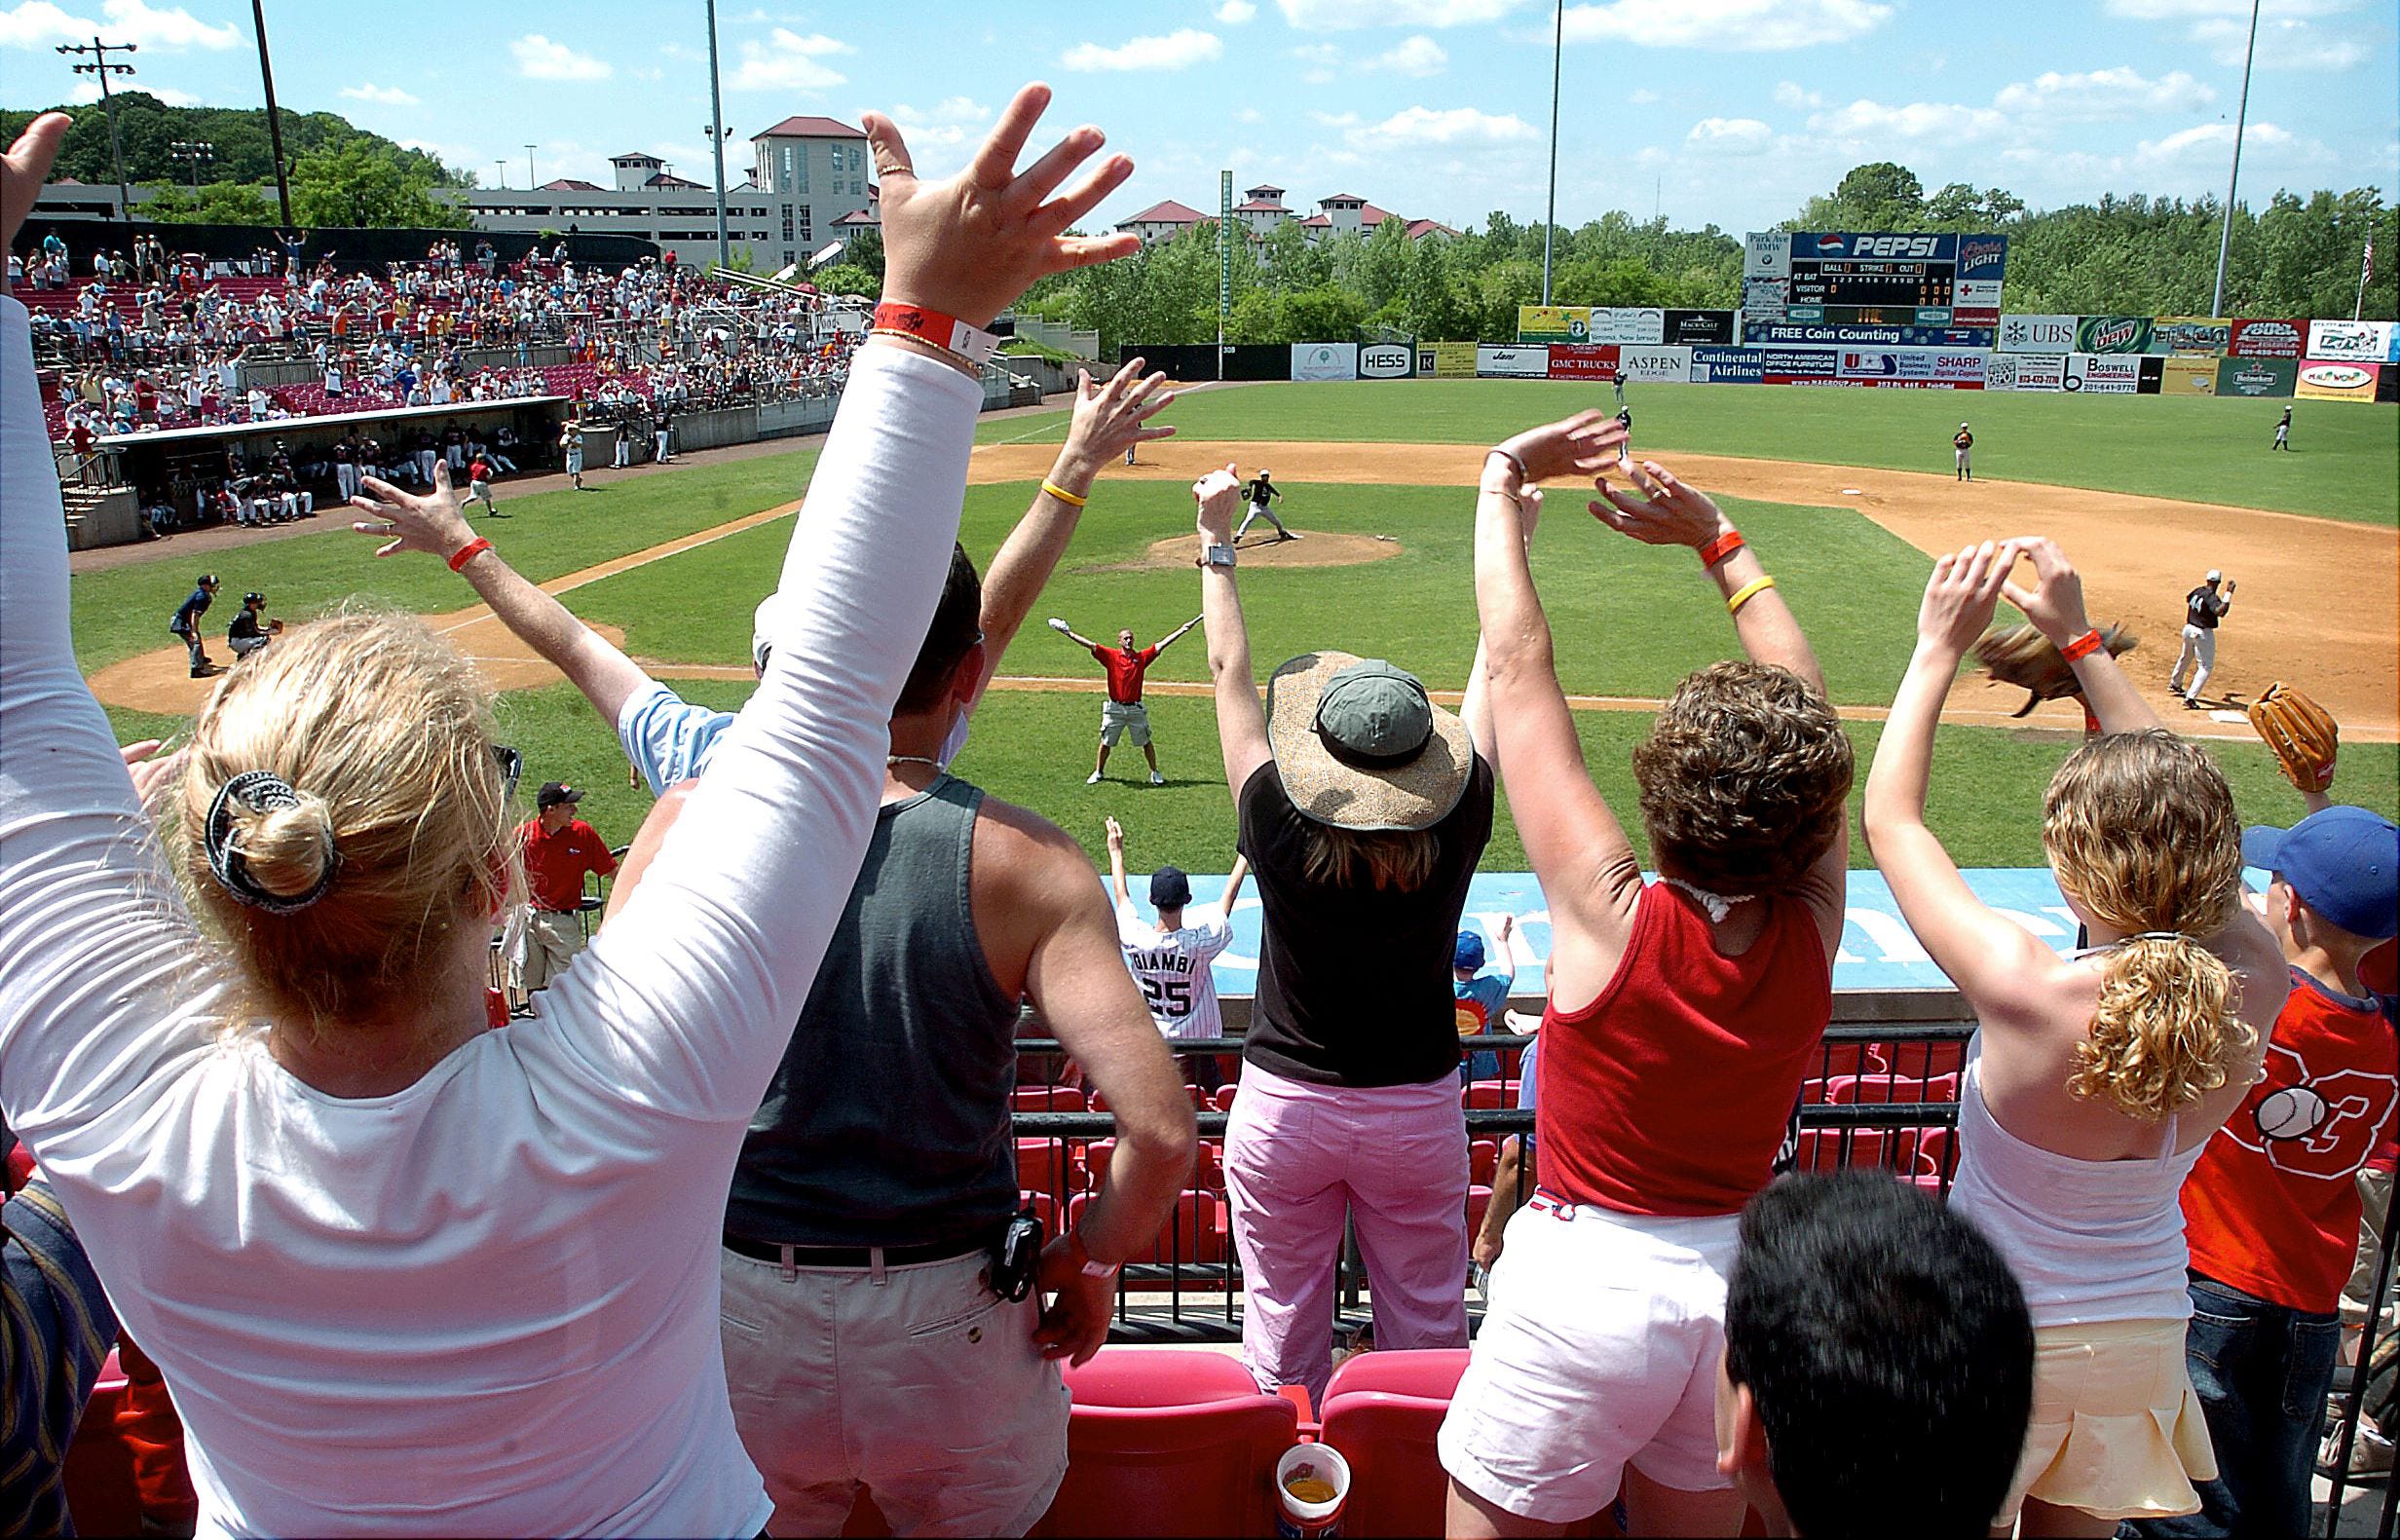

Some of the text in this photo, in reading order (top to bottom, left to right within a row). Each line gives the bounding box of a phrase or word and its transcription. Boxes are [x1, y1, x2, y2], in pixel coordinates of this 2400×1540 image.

[1853, 237, 1938, 257] PEPSI
[1964, 253, 2001, 273] LIGHT
[1795, 284, 1825, 293] VISITOR
[1771, 327, 1899, 342] FREE Coin Counting
[2033, 324, 2074, 343] UBS
[1365, 354, 1406, 368] HESS
[1552, 359, 1617, 370] GMC TRUCKS
[1628, 356, 1682, 370] ASPEN
[1692, 351, 1762, 364] Continental
[1937, 356, 1981, 368] SHARP
[2086, 357, 2135, 373] BOSWELL
[1711, 363, 1762, 378] Airlines
[1958, 369, 1983, 378] Copiers
[1988, 370, 2015, 385] DEPOT
[2189, 594, 2204, 614] 44
[1133, 953, 1197, 975] GIAMBI
[1142, 977, 1192, 1018] 25
